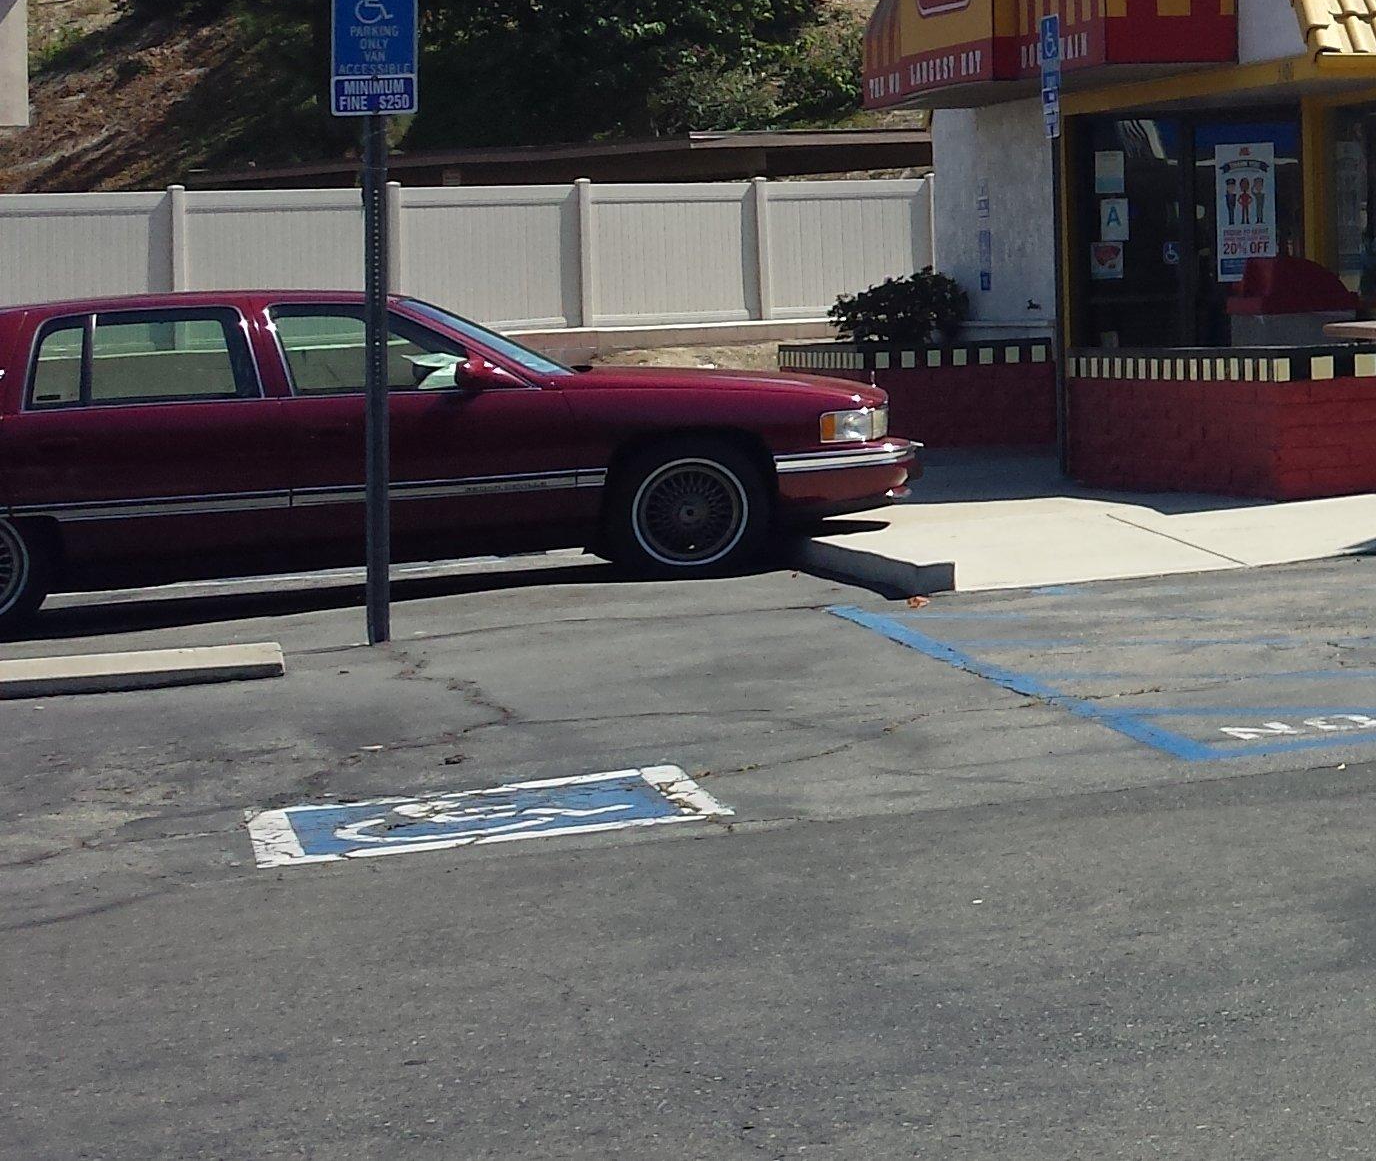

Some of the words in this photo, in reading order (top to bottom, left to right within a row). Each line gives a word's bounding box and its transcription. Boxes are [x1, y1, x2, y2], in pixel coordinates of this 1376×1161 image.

[350, 25, 399, 37] PARKING
[360, 38, 388, 50] ONLY
[364, 51, 386, 62] VAN
[339, 63, 411, 75] ACCESSIBLE
[909, 55, 954, 86] LARGEST
[344, 79, 404, 95] MINIMUM
[339, 96, 368, 111] FINE
[379, 94, 410, 110] $250
[1107, 206, 1121, 227] A
[1223, 242, 1247, 256] 20%
[1250, 241, 1270, 254] OFF
